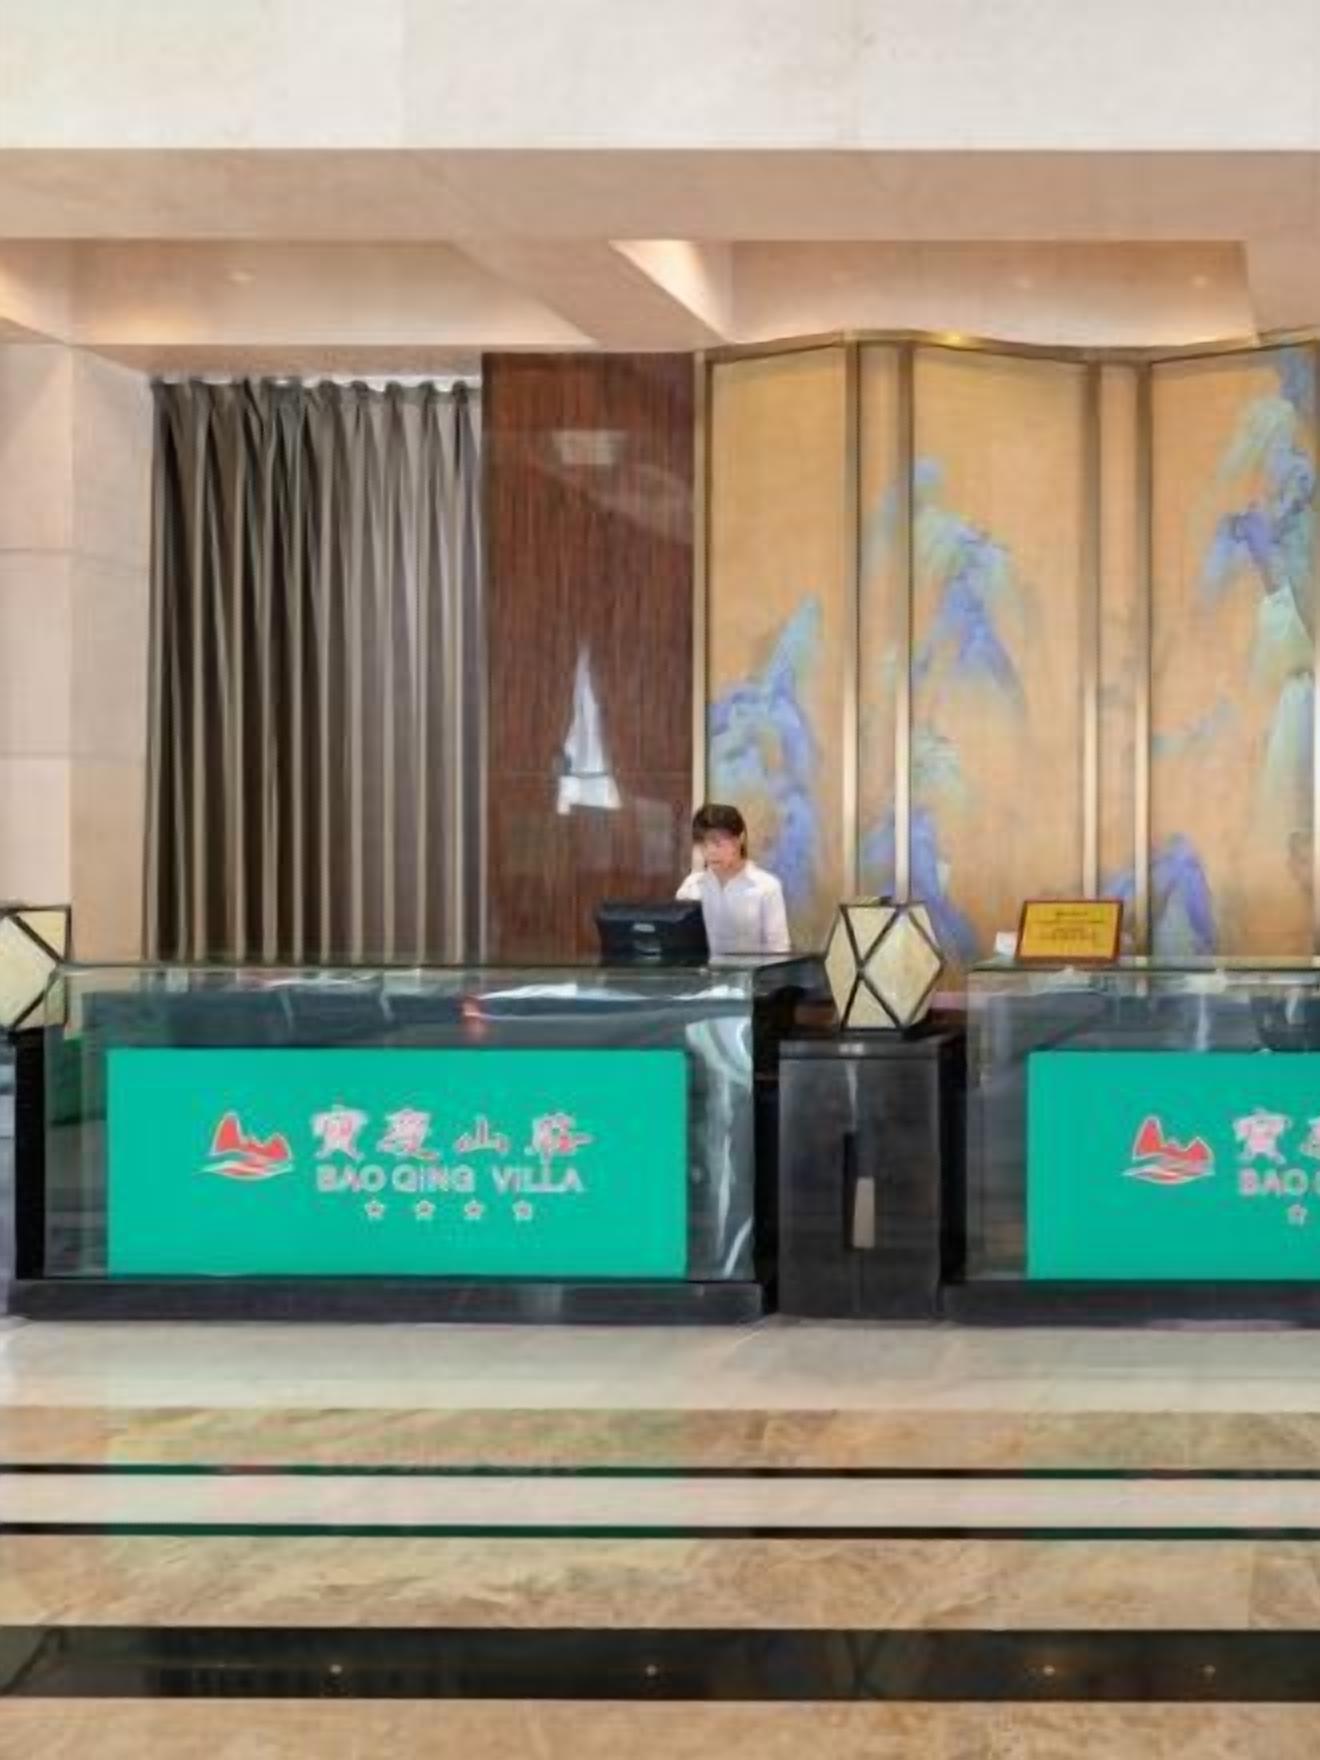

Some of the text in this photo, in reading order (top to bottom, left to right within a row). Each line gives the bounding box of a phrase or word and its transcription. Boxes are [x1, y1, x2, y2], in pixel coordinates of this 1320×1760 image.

[316, 1166, 585, 1193] BAO QING VILLA
[1238, 1168, 1308, 1197] BAO
